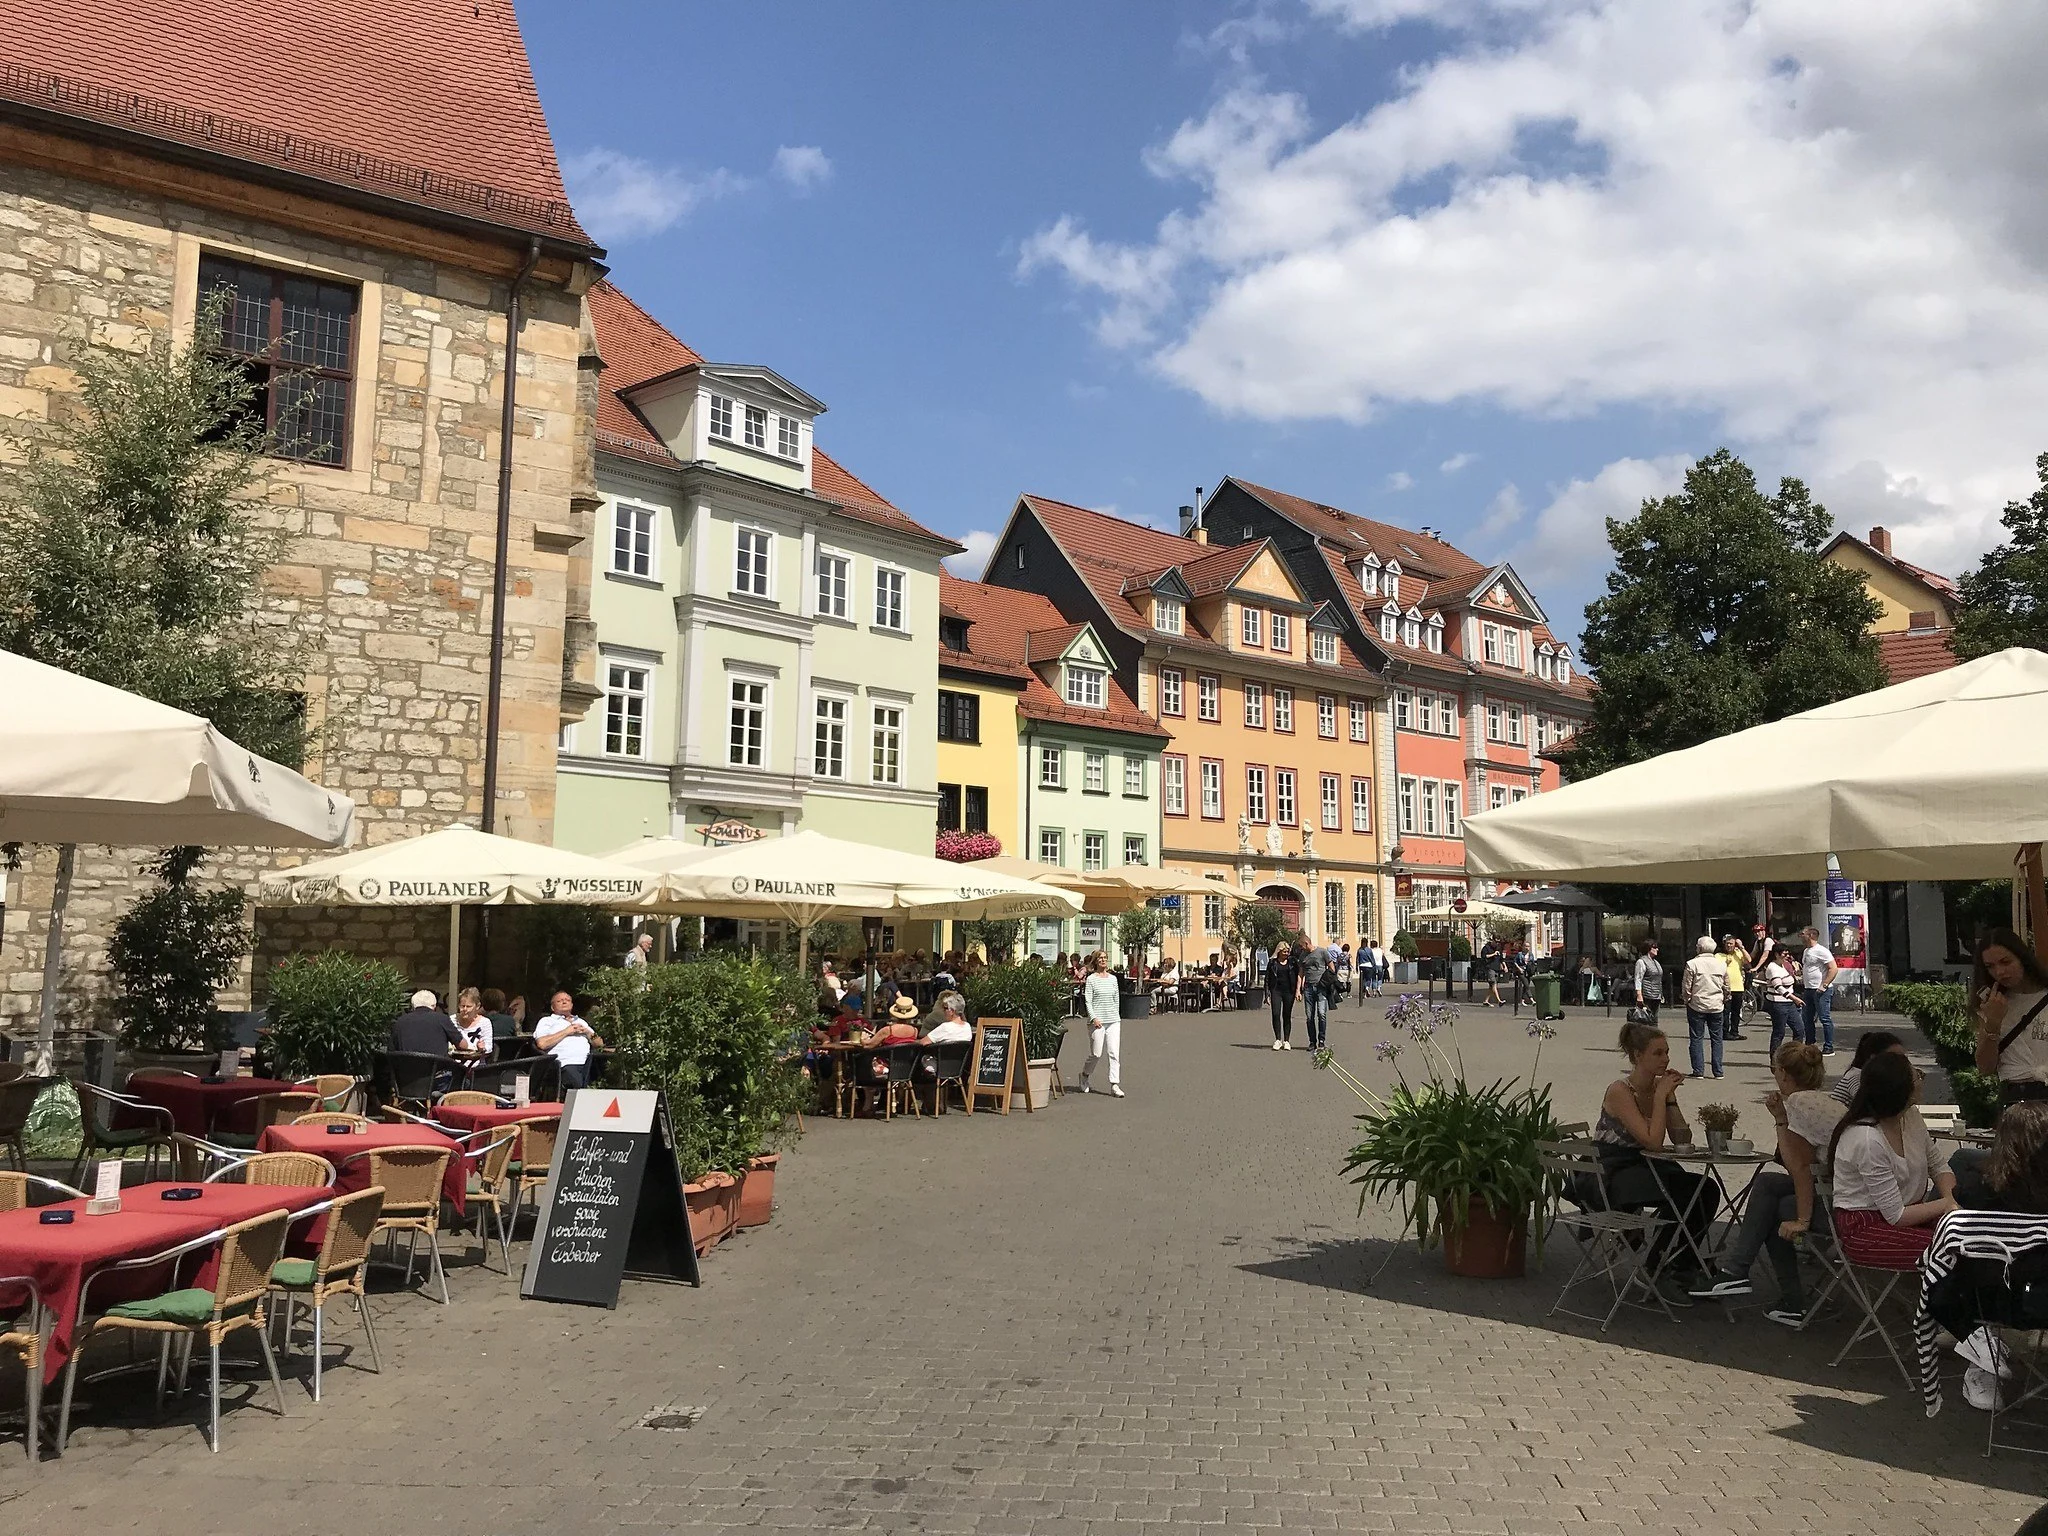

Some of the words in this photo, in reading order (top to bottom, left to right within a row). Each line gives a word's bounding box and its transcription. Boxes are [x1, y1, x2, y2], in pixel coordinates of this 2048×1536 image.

[388, 880, 492, 897] PAULANER
[563, 879, 643, 896] NÜSSLEIN
[754, 878, 837, 897] PAULANER
[573, 1205, 601, 1221] sowie
[551, 1220, 608, 1239] verschiedene
[551, 1240, 602, 1264] Eisbecher
